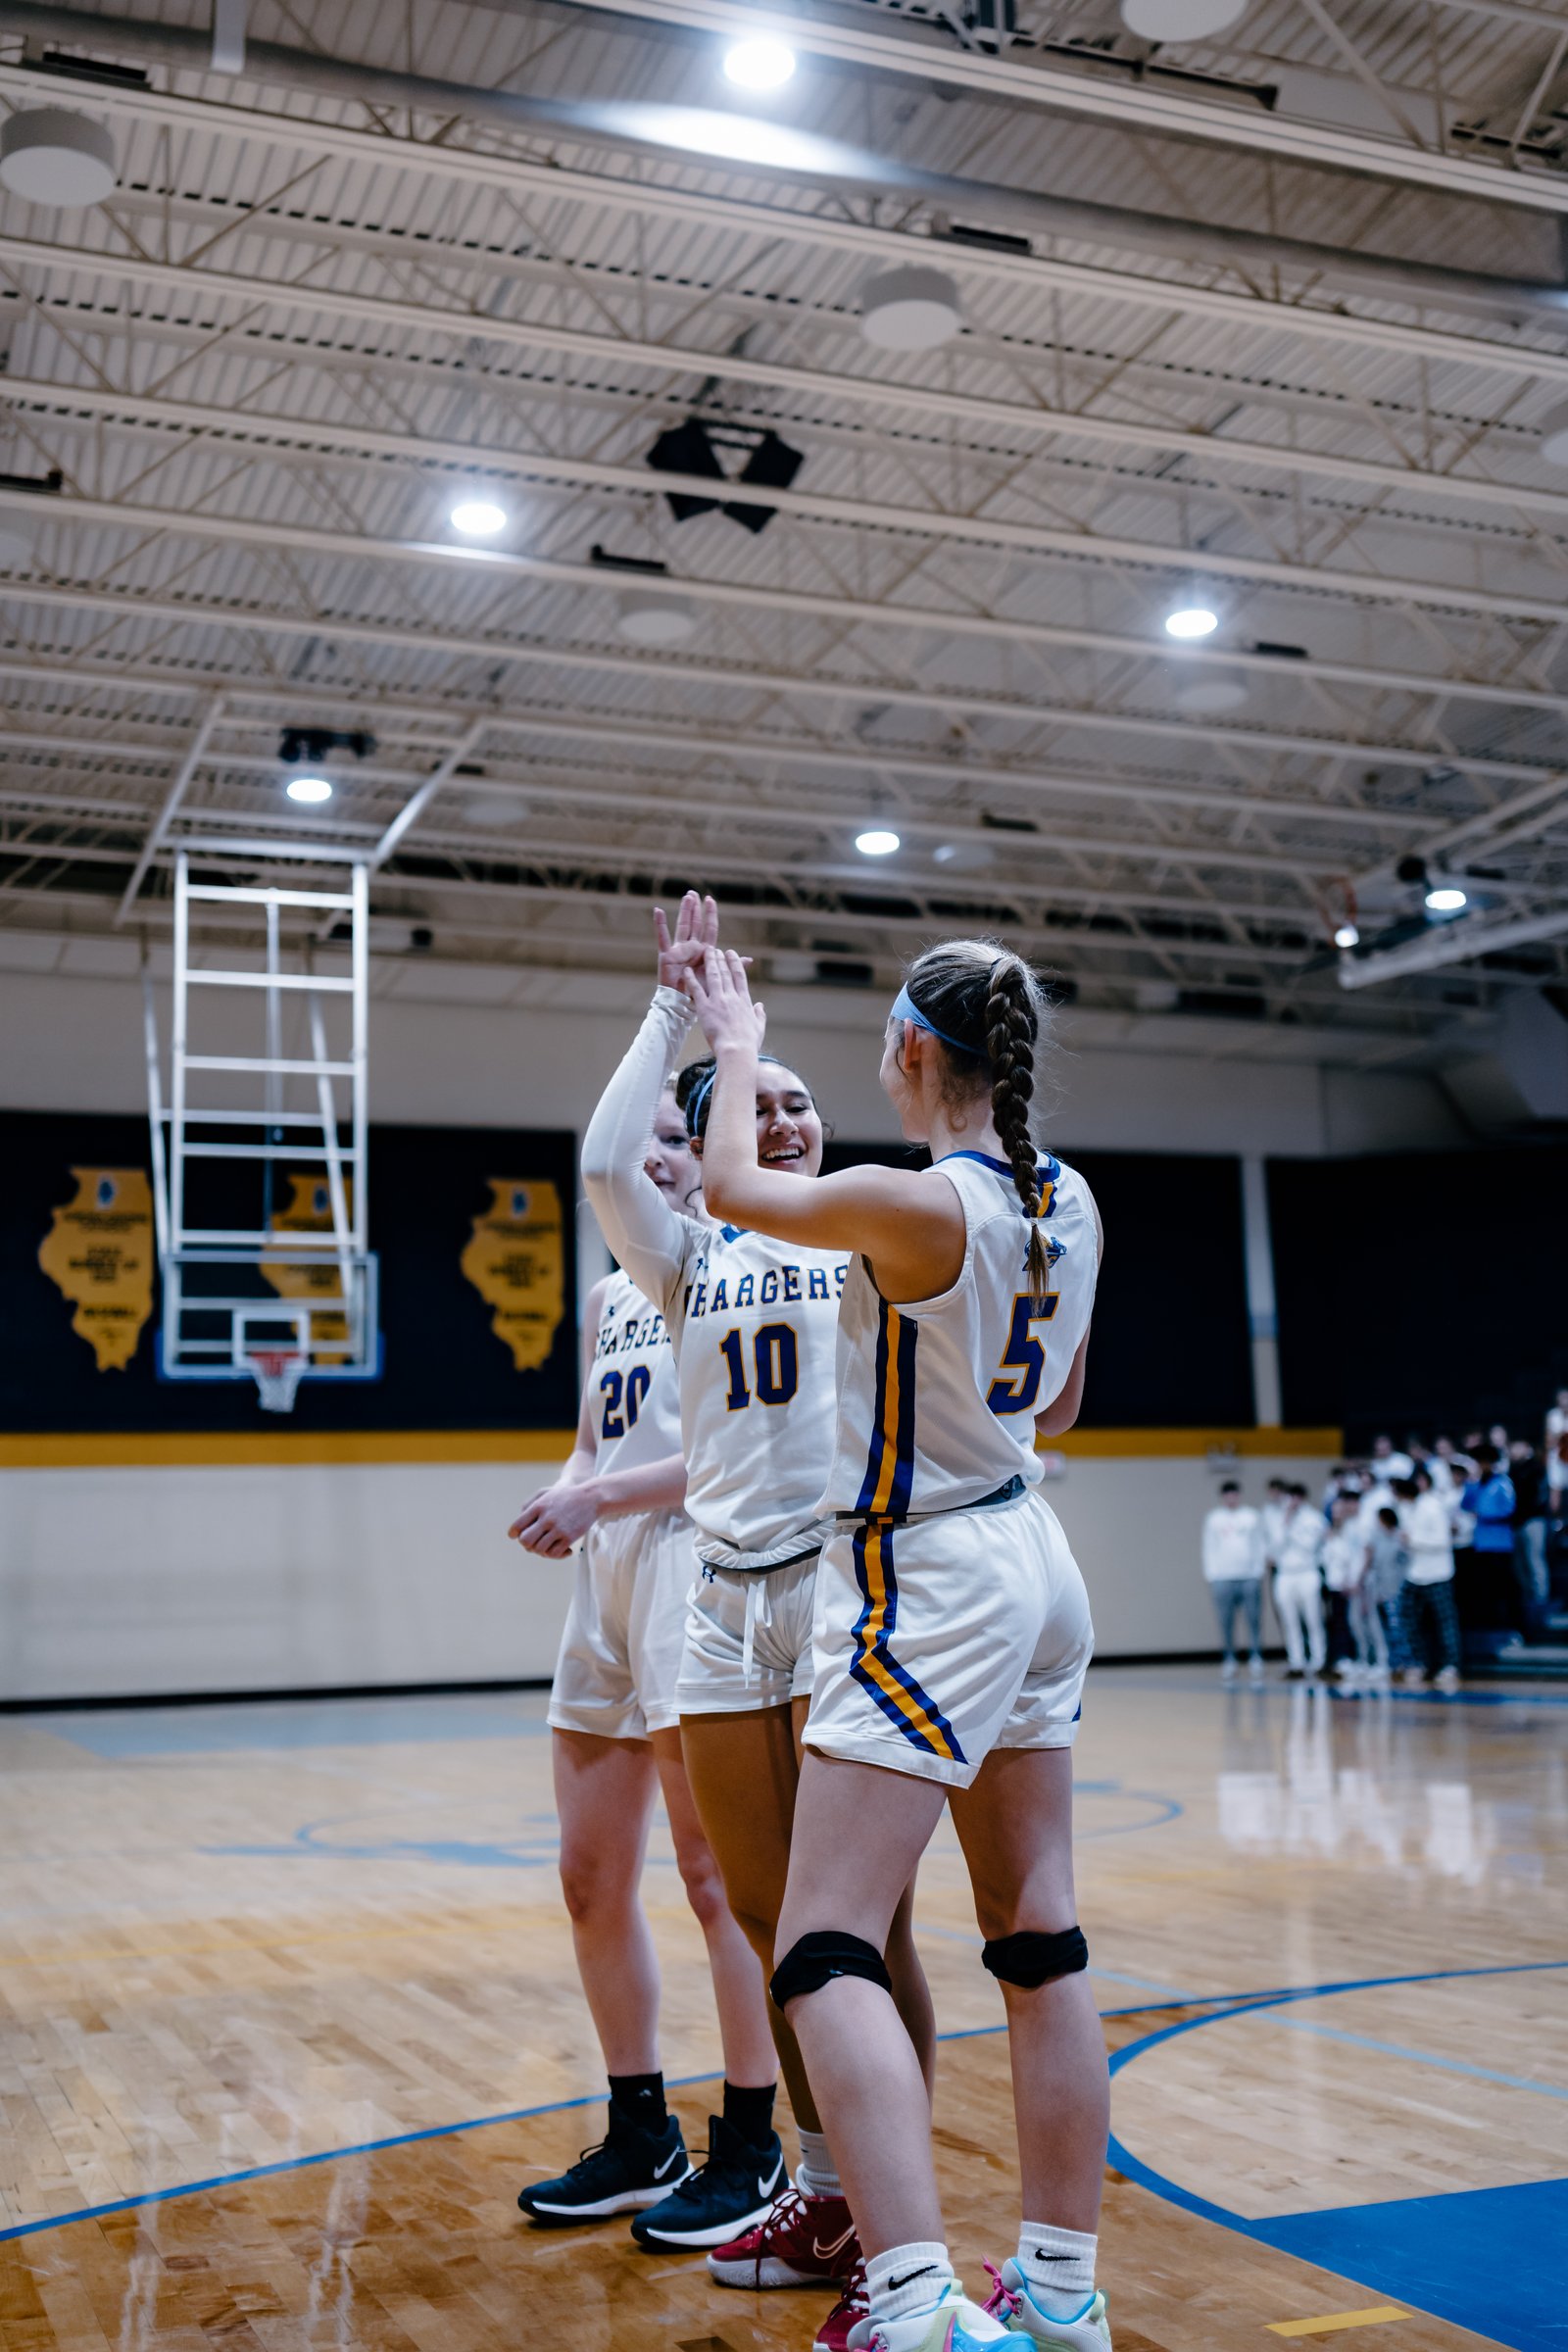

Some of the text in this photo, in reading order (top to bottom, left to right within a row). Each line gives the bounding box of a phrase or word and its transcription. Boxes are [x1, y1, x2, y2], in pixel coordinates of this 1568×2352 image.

[593, 1314, 670, 1360] HARGE
[718, 1321, 799, 1411] 10
[986, 1292, 1060, 1415] 5
[600, 1364, 651, 1440] 20
